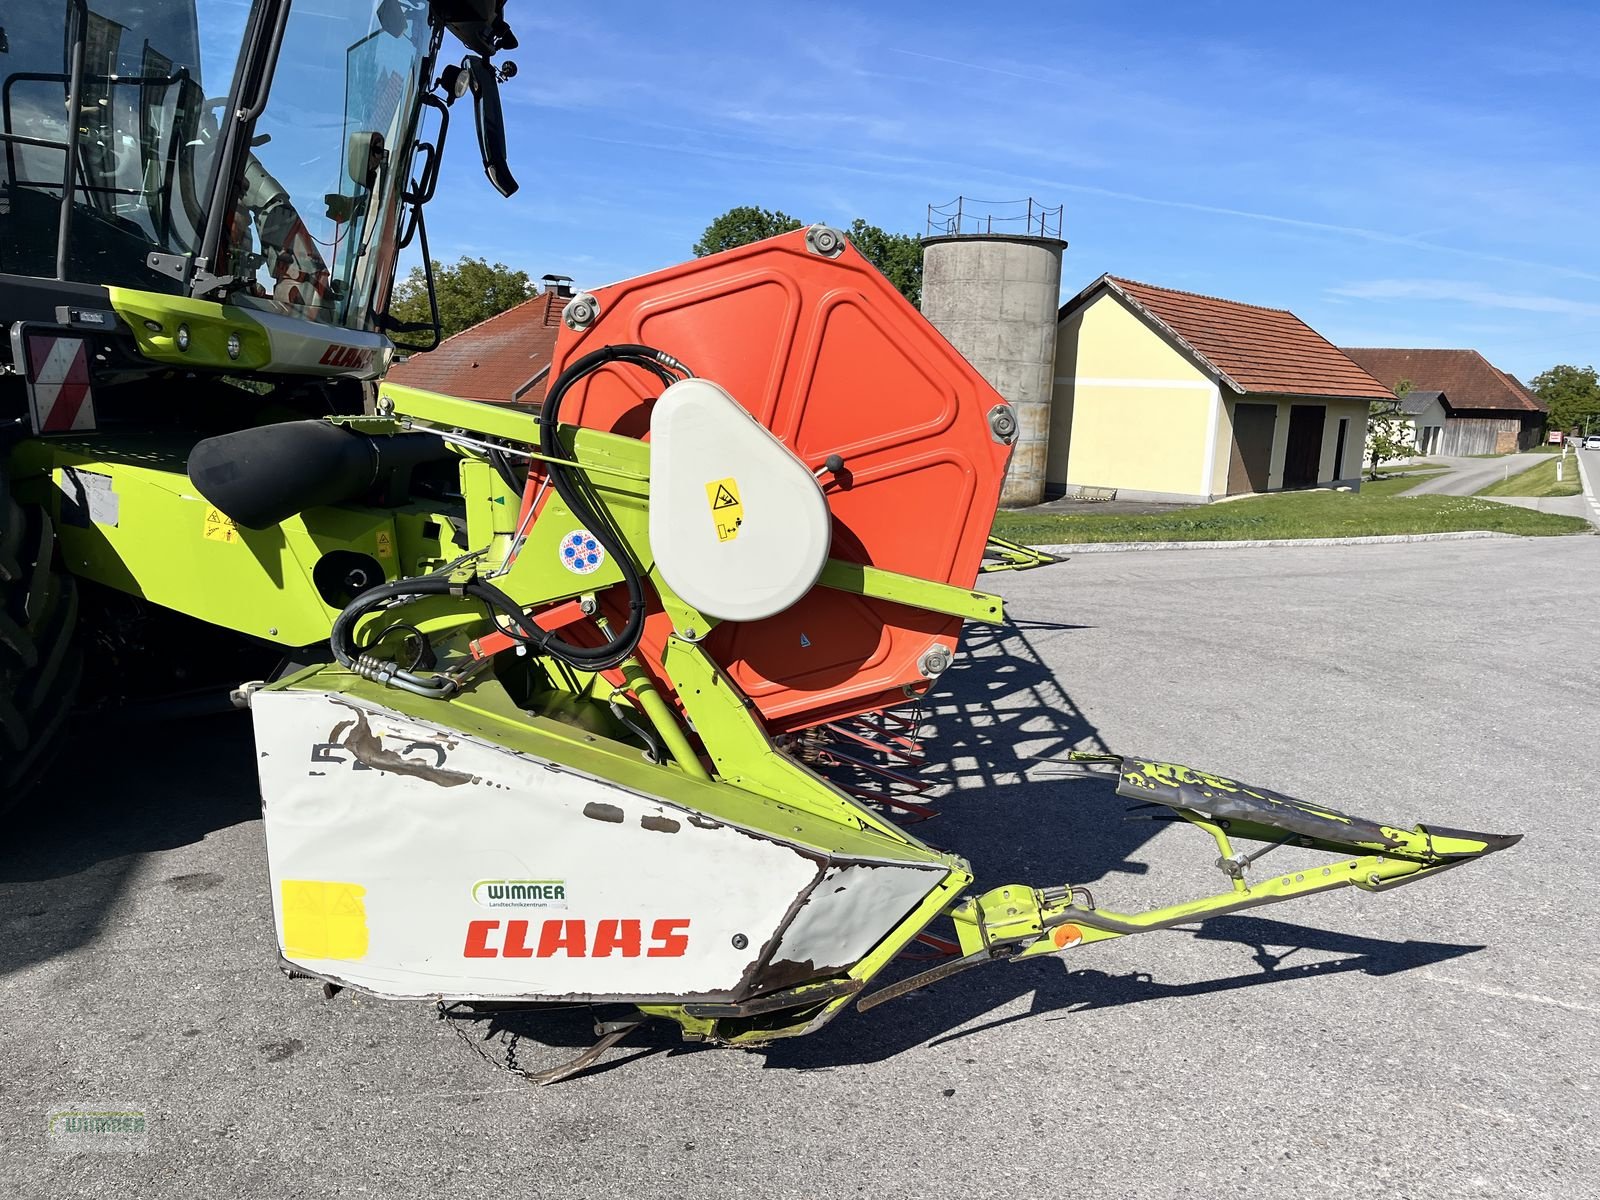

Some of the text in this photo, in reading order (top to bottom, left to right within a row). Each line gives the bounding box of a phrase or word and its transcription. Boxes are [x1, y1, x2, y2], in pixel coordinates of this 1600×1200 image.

[488, 885, 565, 900] WIMMER
[489, 901, 548, 909] Landtechnikzentrum
[463, 918, 691, 958] CLAAS
